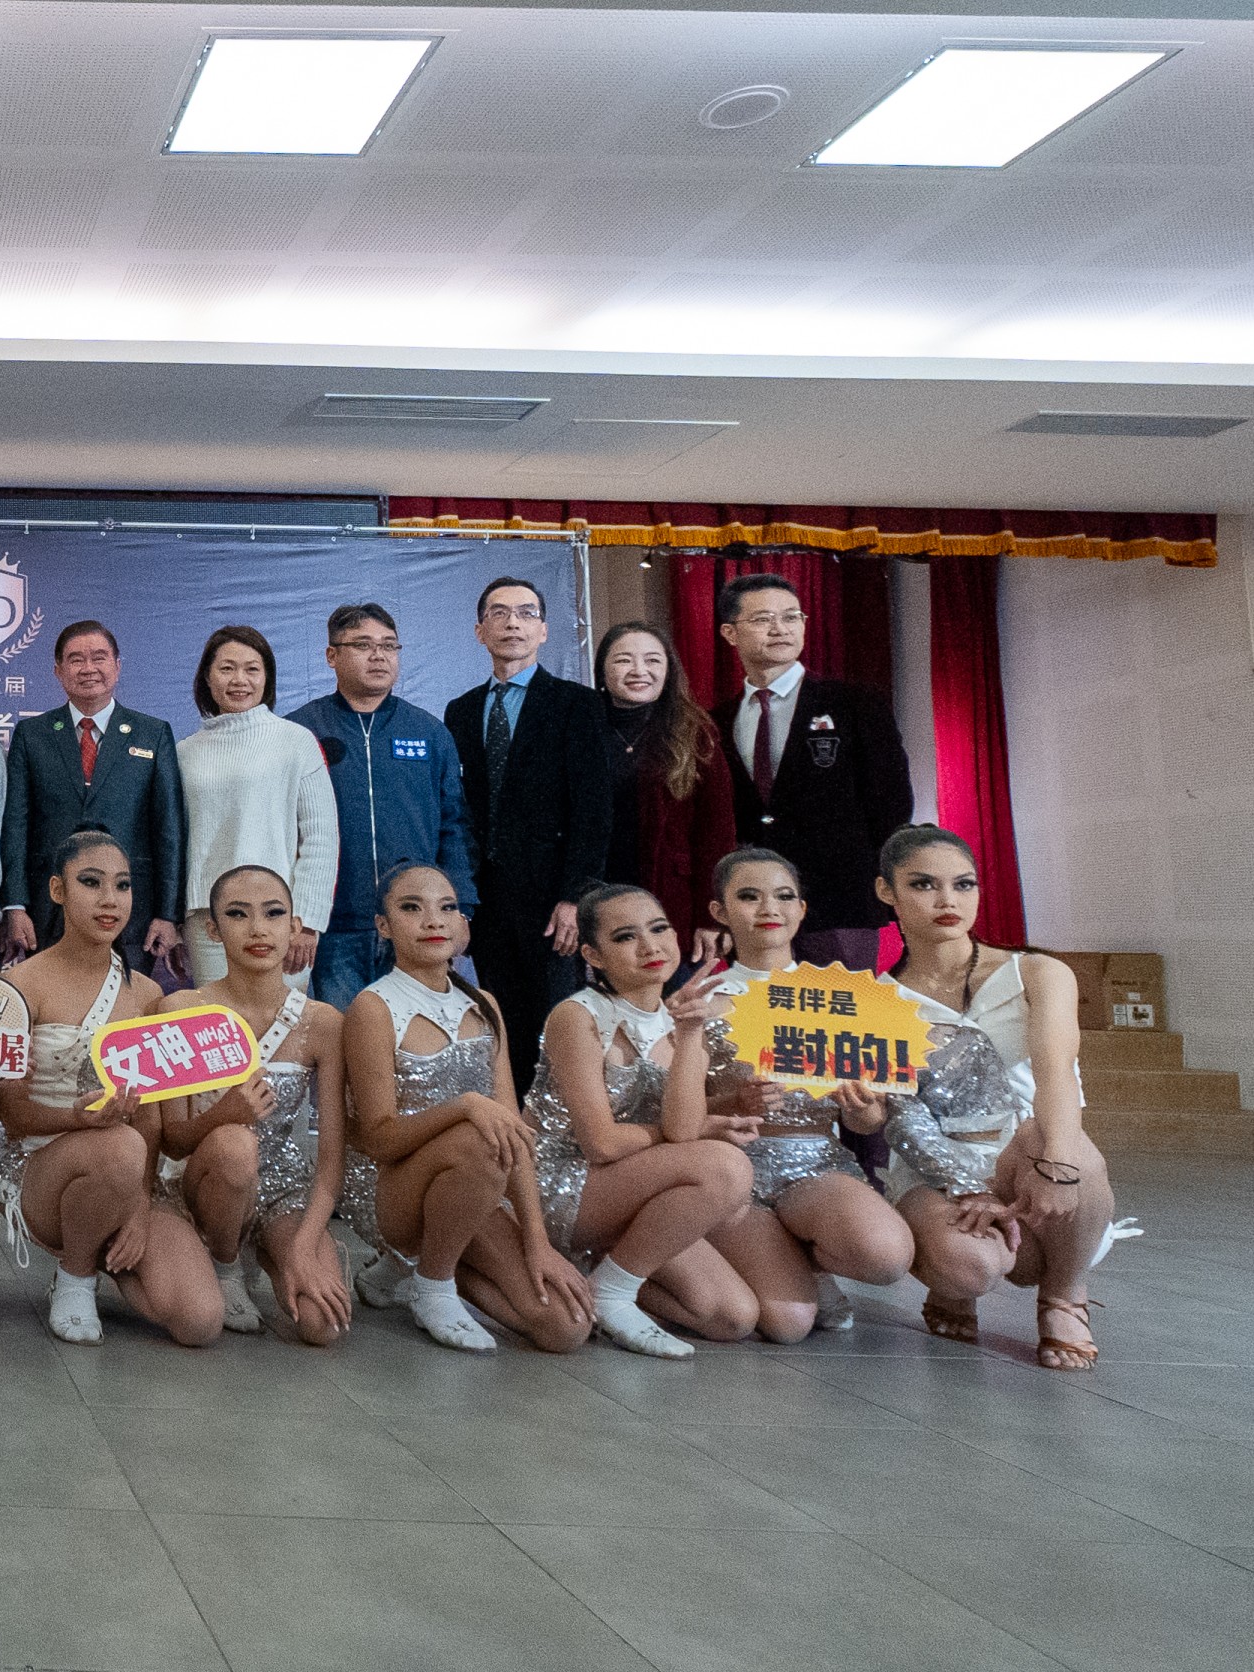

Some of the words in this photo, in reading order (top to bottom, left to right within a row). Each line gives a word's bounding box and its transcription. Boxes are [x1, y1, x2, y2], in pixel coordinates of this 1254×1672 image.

[767, 984, 858, 1017] 舞伴是
[194, 1012, 241, 1047] WHAT!
[101, 1023, 196, 1098] 女神
[201, 1043, 248, 1074] 駕到
[773, 1025, 910, 1083] 對的!
